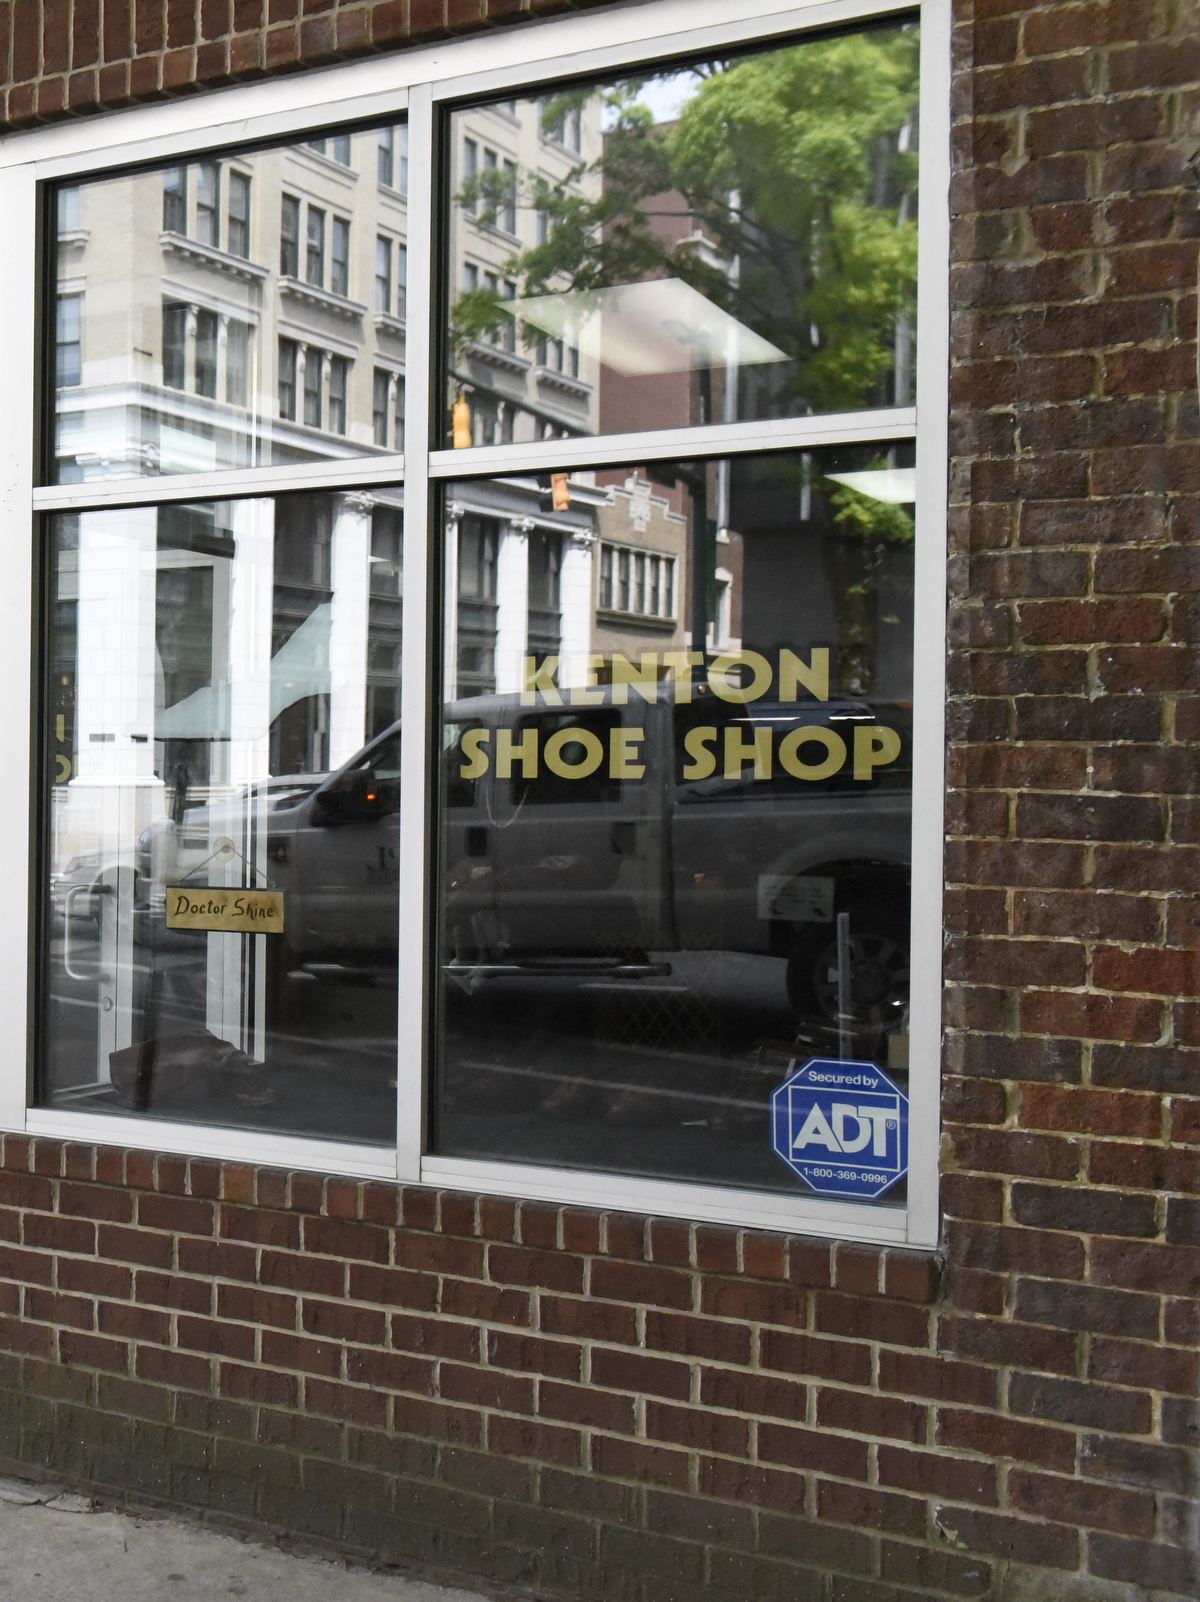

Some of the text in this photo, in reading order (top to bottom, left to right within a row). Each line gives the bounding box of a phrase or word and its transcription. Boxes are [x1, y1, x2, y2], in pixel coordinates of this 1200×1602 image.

[520, 647, 830, 706] KENTON
[460, 725, 902, 781] SHOE SHOP
[175, 895, 274, 919] Doctor Shine
[808, 1070, 879, 1088] Secured by
[792, 1102, 898, 1157] ADT
[803, 1167, 888, 1184] 1-800-369-0996
